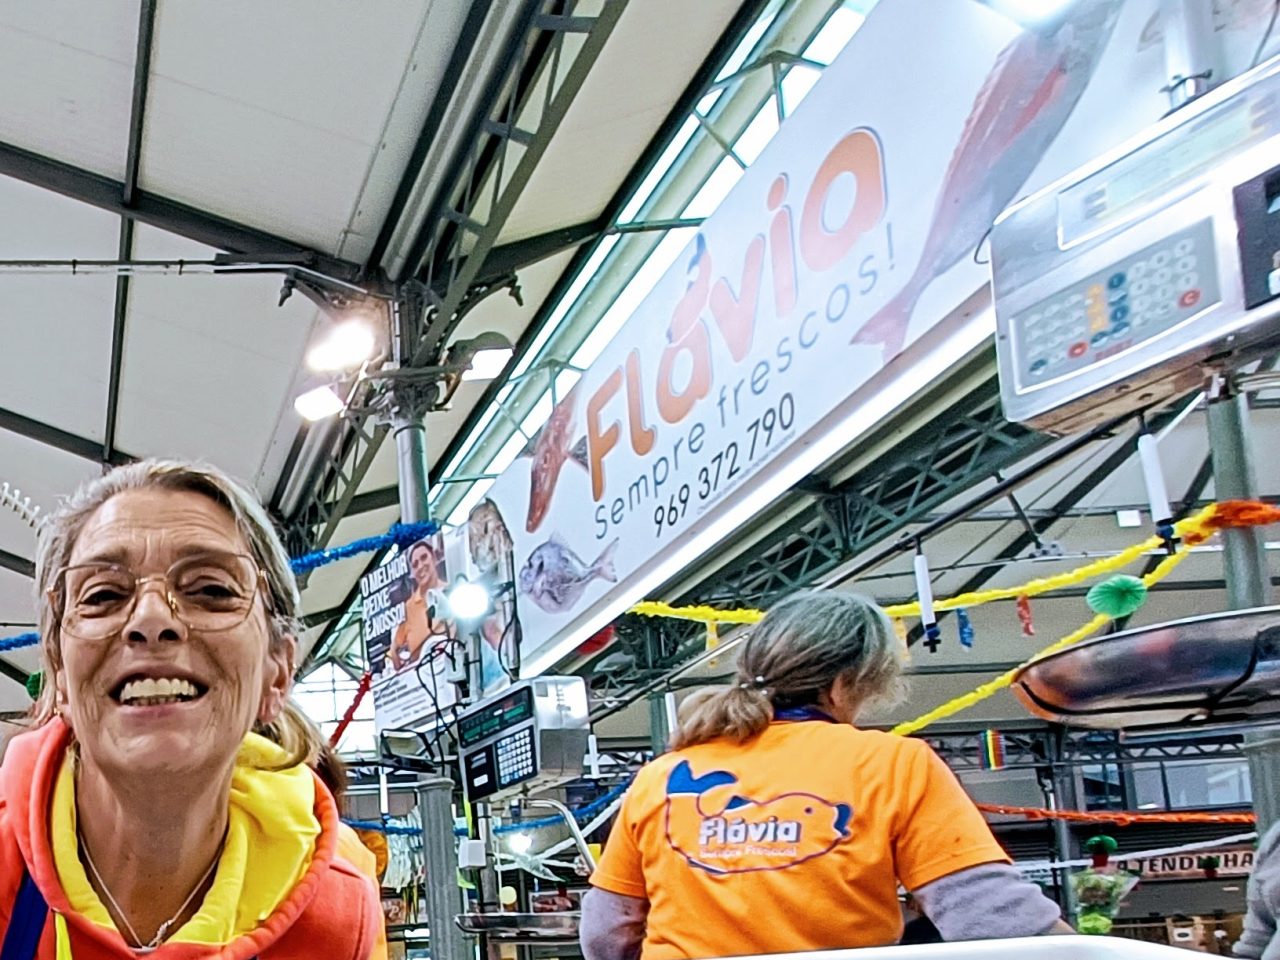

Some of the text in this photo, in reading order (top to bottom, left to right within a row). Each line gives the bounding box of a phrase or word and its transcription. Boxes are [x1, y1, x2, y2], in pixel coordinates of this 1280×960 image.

[716, 222, 895, 427] frescos!
[654, 483, 690, 538] 969
[698, 441, 741, 500] 372
[746, 392, 795, 462] 790
[360, 553, 409, 598] O MELHOR
[362, 586, 392, 621] PEIXE
[699, 815, 802, 845] Flávia
